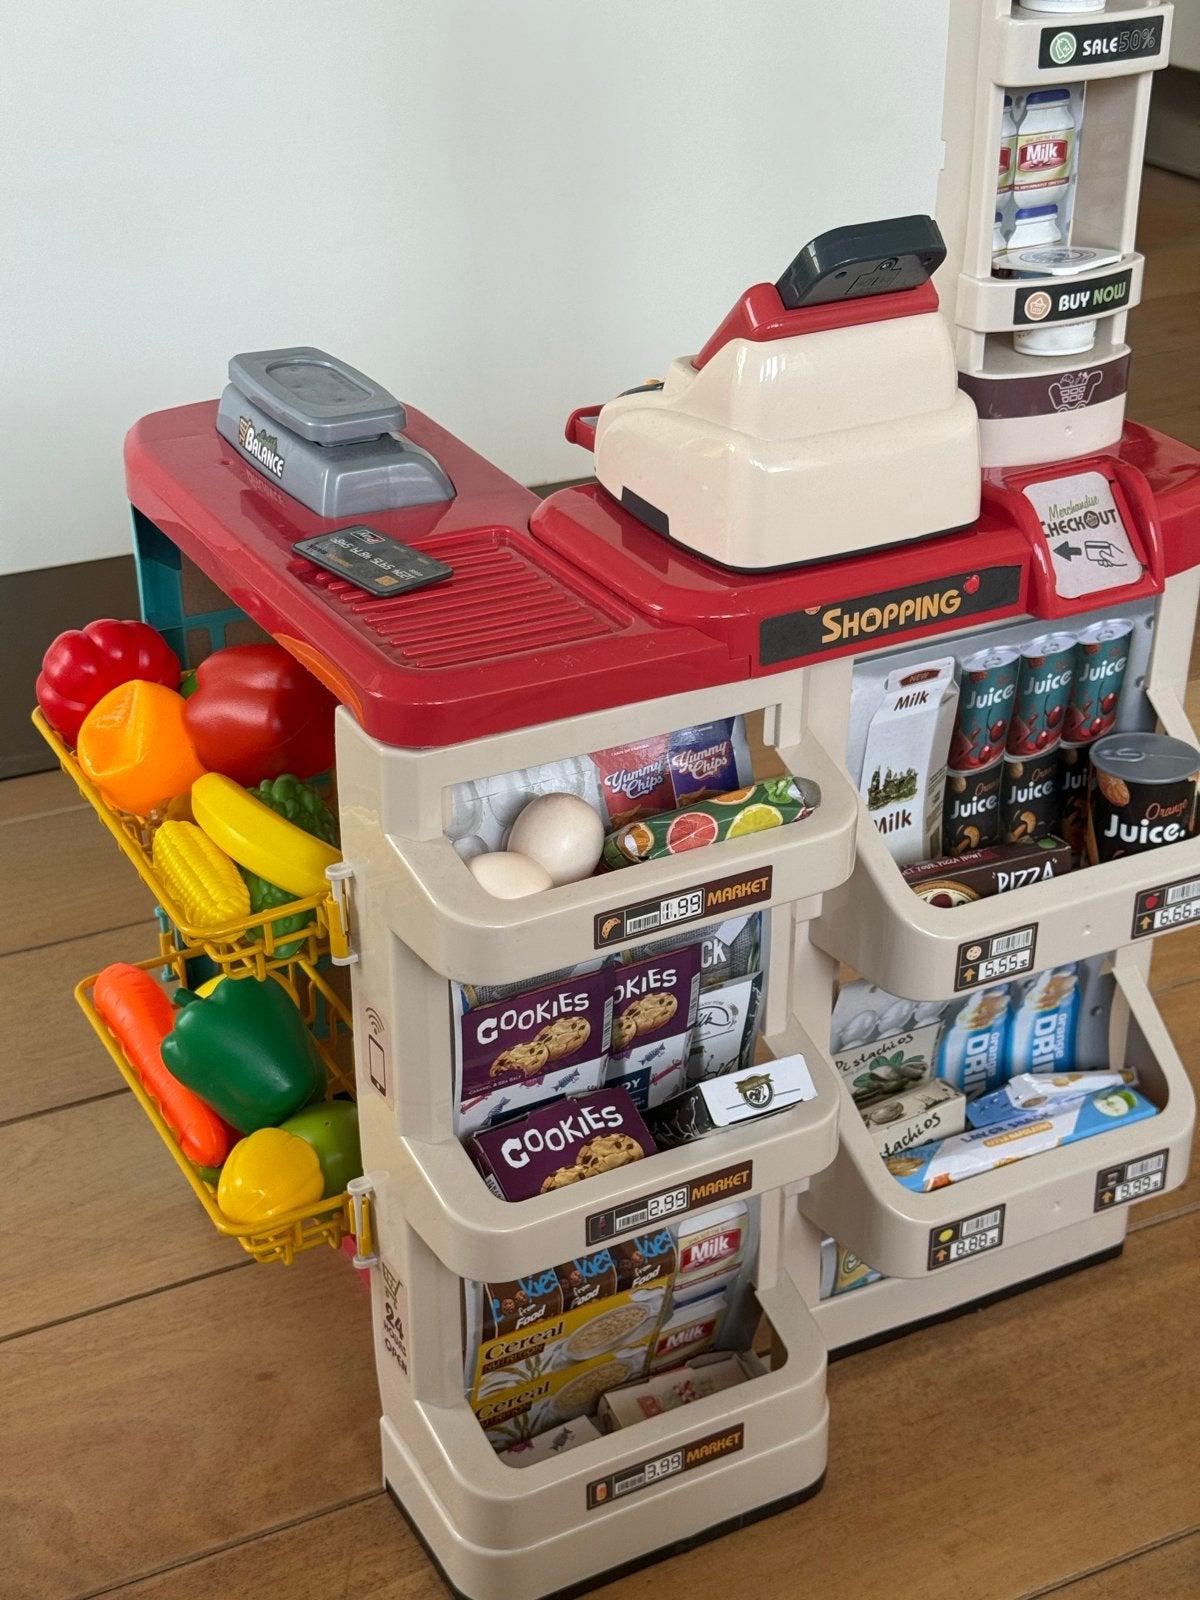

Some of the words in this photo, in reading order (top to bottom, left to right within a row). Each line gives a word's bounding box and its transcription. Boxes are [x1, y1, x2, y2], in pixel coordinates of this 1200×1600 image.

[1082, 37, 1118, 56] SALE
[1119, 27, 1156, 52] 50%
[1026, 143, 1058, 165] Milk
[1058, 291, 1090, 311] BUY
[1092, 282, 1126, 305] NOW
[245, 427, 284, 478] BALANCE
[1048, 495, 1099, 521] Merchandise
[822, 589, 961, 644] SHOPPING
[909, 671, 929, 682] NEW
[1024, 670, 1072, 695] Juice
[1079, 657, 1127, 682] Juice
[894, 690, 930, 711] Milk
[966, 683, 1015, 709] Juice
[672, 741, 728, 773] Yummy
[689, 756, 728, 779] Chips
[604, 760, 662, 793] Yummy
[622, 775, 664, 799] Chips
[1062, 767, 1090, 790] Jui
[1008, 781, 1053, 804] Juice
[951, 795, 997, 819] Juice
[707, 877, 769, 906] MARKET
[614, 968, 677, 1004] OKIES
[477, 992, 590, 1045] COOKIES
[501, 1105, 624, 1168] COOKIES
[650, 1190, 685, 1217] 2.99
[692, 1170, 749, 1200] MARKET
[690, 1235, 729, 1263] Milk
[632, 1265, 661, 1289] Food
[634, 1264, 652, 1277] from
[571, 1285, 600, 1309] Food
[573, 1284, 591, 1297] from
[386, 1302, 404, 1340] 24
[515, 1304, 546, 1330] Food
[518, 1303, 537, 1316] from
[485, 1321, 563, 1360] Cereal
[666, 1325, 705, 1347] Milk
[385, 1338, 407, 1375] OPEN
[476, 1381, 549, 1419] Cereal
[647, 1454, 680, 1480] 3.99
[687, 1432, 742, 1463] MARKET
